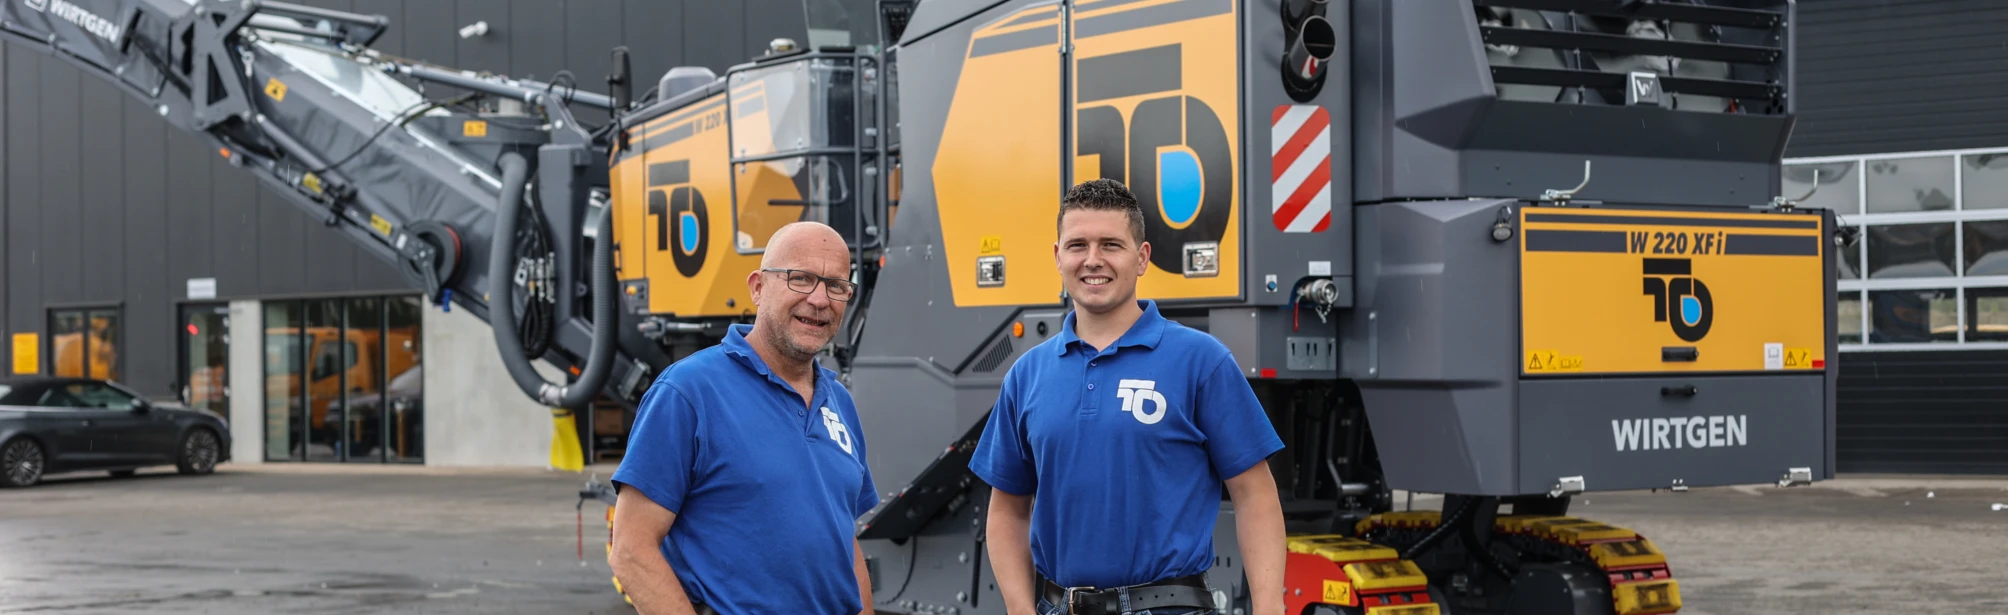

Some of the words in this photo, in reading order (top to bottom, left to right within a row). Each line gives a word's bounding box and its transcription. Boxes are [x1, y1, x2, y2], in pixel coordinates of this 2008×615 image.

[50, 0, 120, 43] WIRTGEN
[704, 110, 721, 132] 220
[1630, 231, 1649, 254] W
[1652, 231, 1688, 255] 220
[1611, 414, 1747, 452] WIRTGEN
